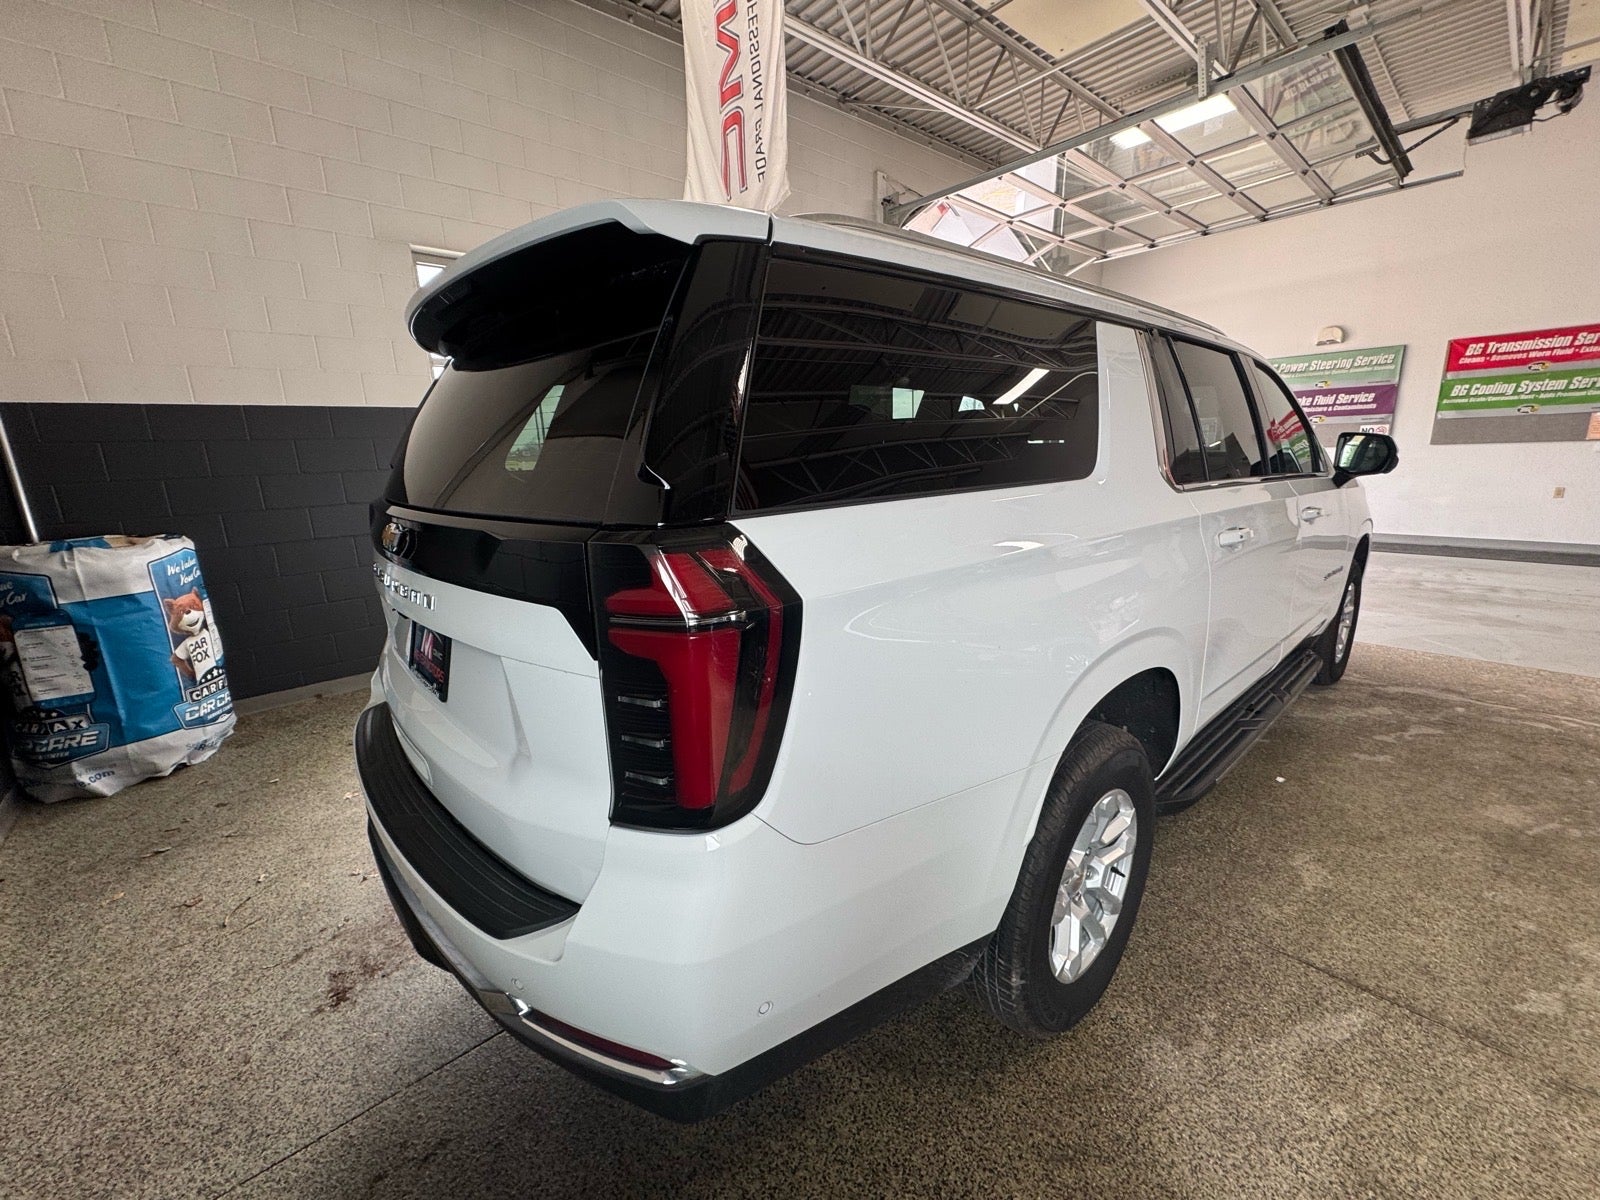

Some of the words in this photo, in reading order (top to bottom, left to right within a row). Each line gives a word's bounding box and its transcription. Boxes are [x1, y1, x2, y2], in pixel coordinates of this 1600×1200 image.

[1464, 343, 1485, 356] BG
[1486, 335, 1573, 354] Transmission
[1278, 363, 1309, 373] Power
[1309, 358, 1354, 371] Steering
[1354, 353, 1395, 367] Service
[1450, 384, 1470, 396] BG
[1469, 382, 1517, 396] Cooling
[1517, 379, 1568, 395] System
[1312, 394, 1336, 406] Fluid
[1336, 392, 1376, 404] Service
[167, 562, 181, 576] We
[6, 591, 27, 605] Car
[188, 636, 208, 654] CAR
[192, 647, 211, 665] FOX
